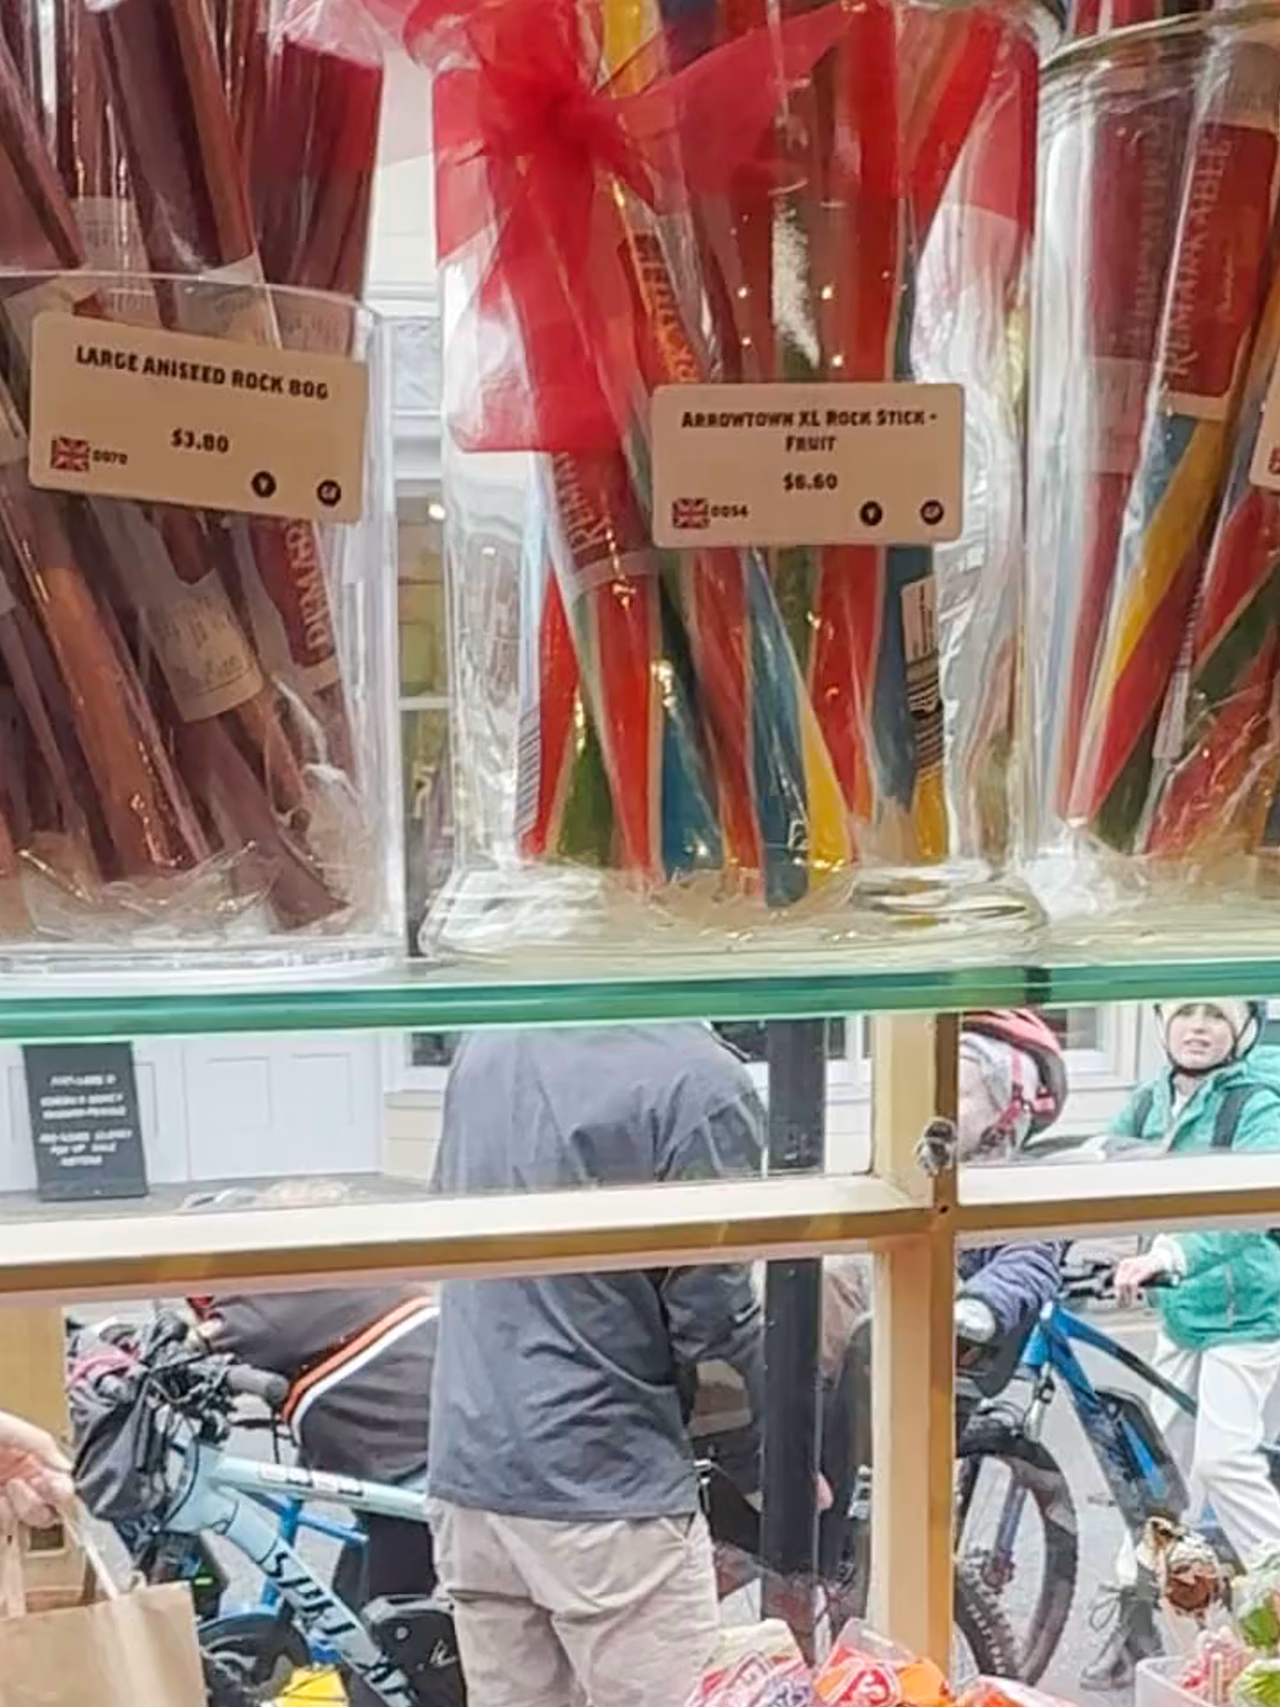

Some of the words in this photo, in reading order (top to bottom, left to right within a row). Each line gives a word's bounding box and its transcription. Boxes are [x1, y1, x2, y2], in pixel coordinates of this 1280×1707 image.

[77, 346, 138, 373] LARGE
[142, 356, 226, 386] ANISEED
[231, 370, 284, 394] ROCK
[682, 411, 793, 428] ARROWTOWN
[798, 411, 820, 427] XL
[826, 410, 871, 426] ROCK
[876, 410, 925, 426] STICK
[171, 428, 230, 454] $3.80
[785, 435, 837, 453] FRUIT
